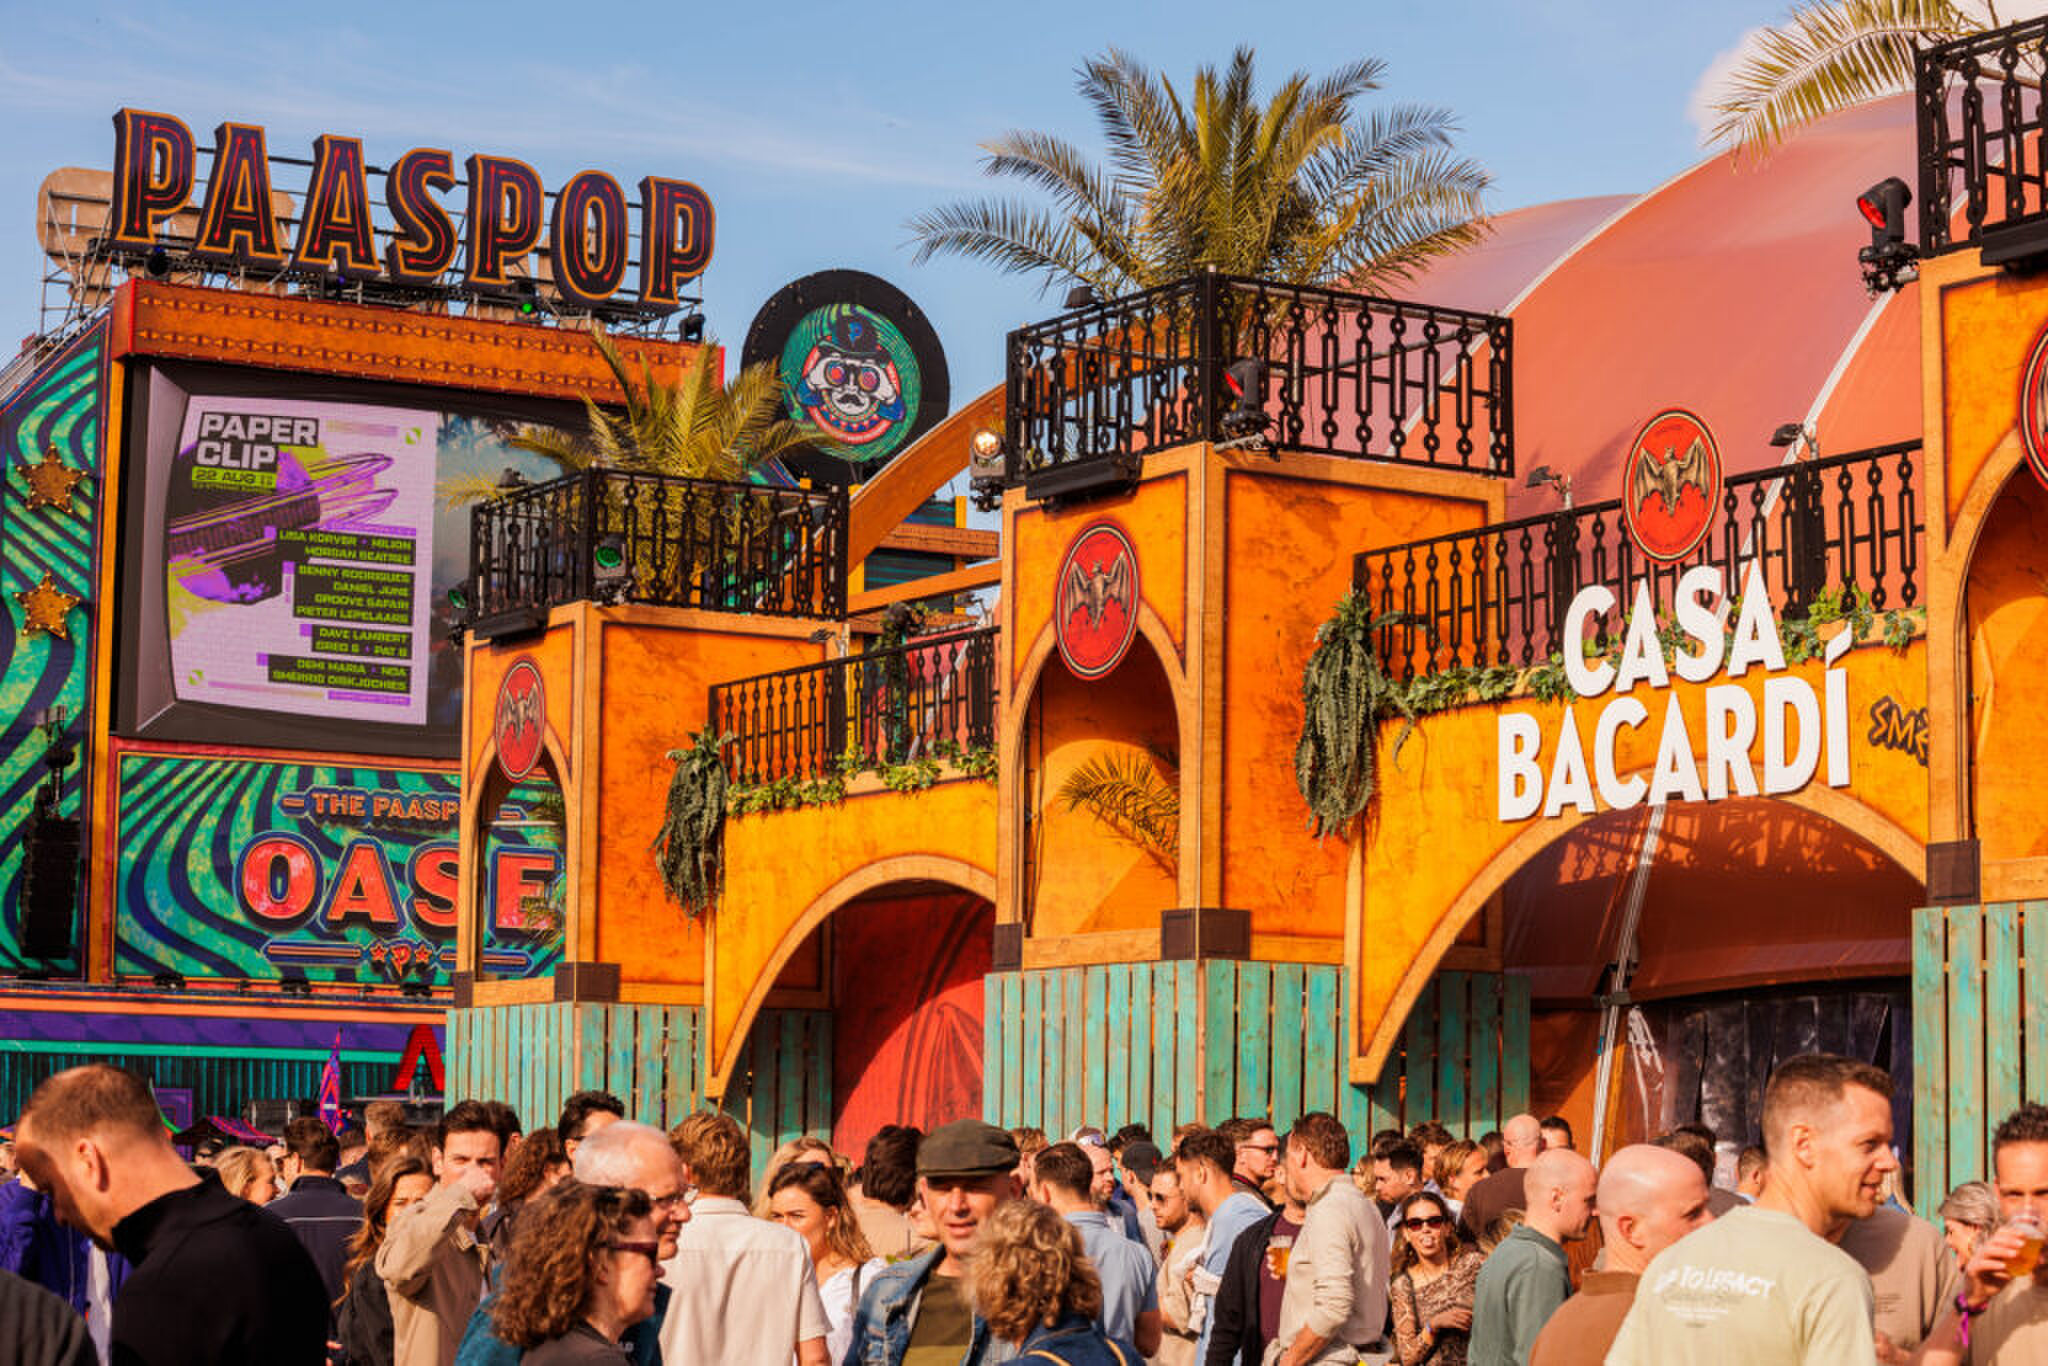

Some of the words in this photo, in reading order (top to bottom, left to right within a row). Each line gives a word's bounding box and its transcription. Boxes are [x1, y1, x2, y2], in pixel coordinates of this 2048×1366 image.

[112, 108, 715, 313] PAASPOP
[200, 413, 316, 446] PAPER
[197, 440, 275, 470] CLIP
[195, 469, 218, 481] 22
[222, 471, 256, 484] AUG
[298, 565, 339, 577] BENNY
[319, 627, 350, 640] DAVE
[353, 630, 409, 644] LAMBERT
[1564, 557, 1787, 698] CASA
[327, 662, 366, 674] MARIA
[1497, 621, 1853, 822] BACARDÍ
[311, 792, 366, 817] THE
[372, 795, 461, 822] PAASP
[242, 836, 556, 930] OASE
